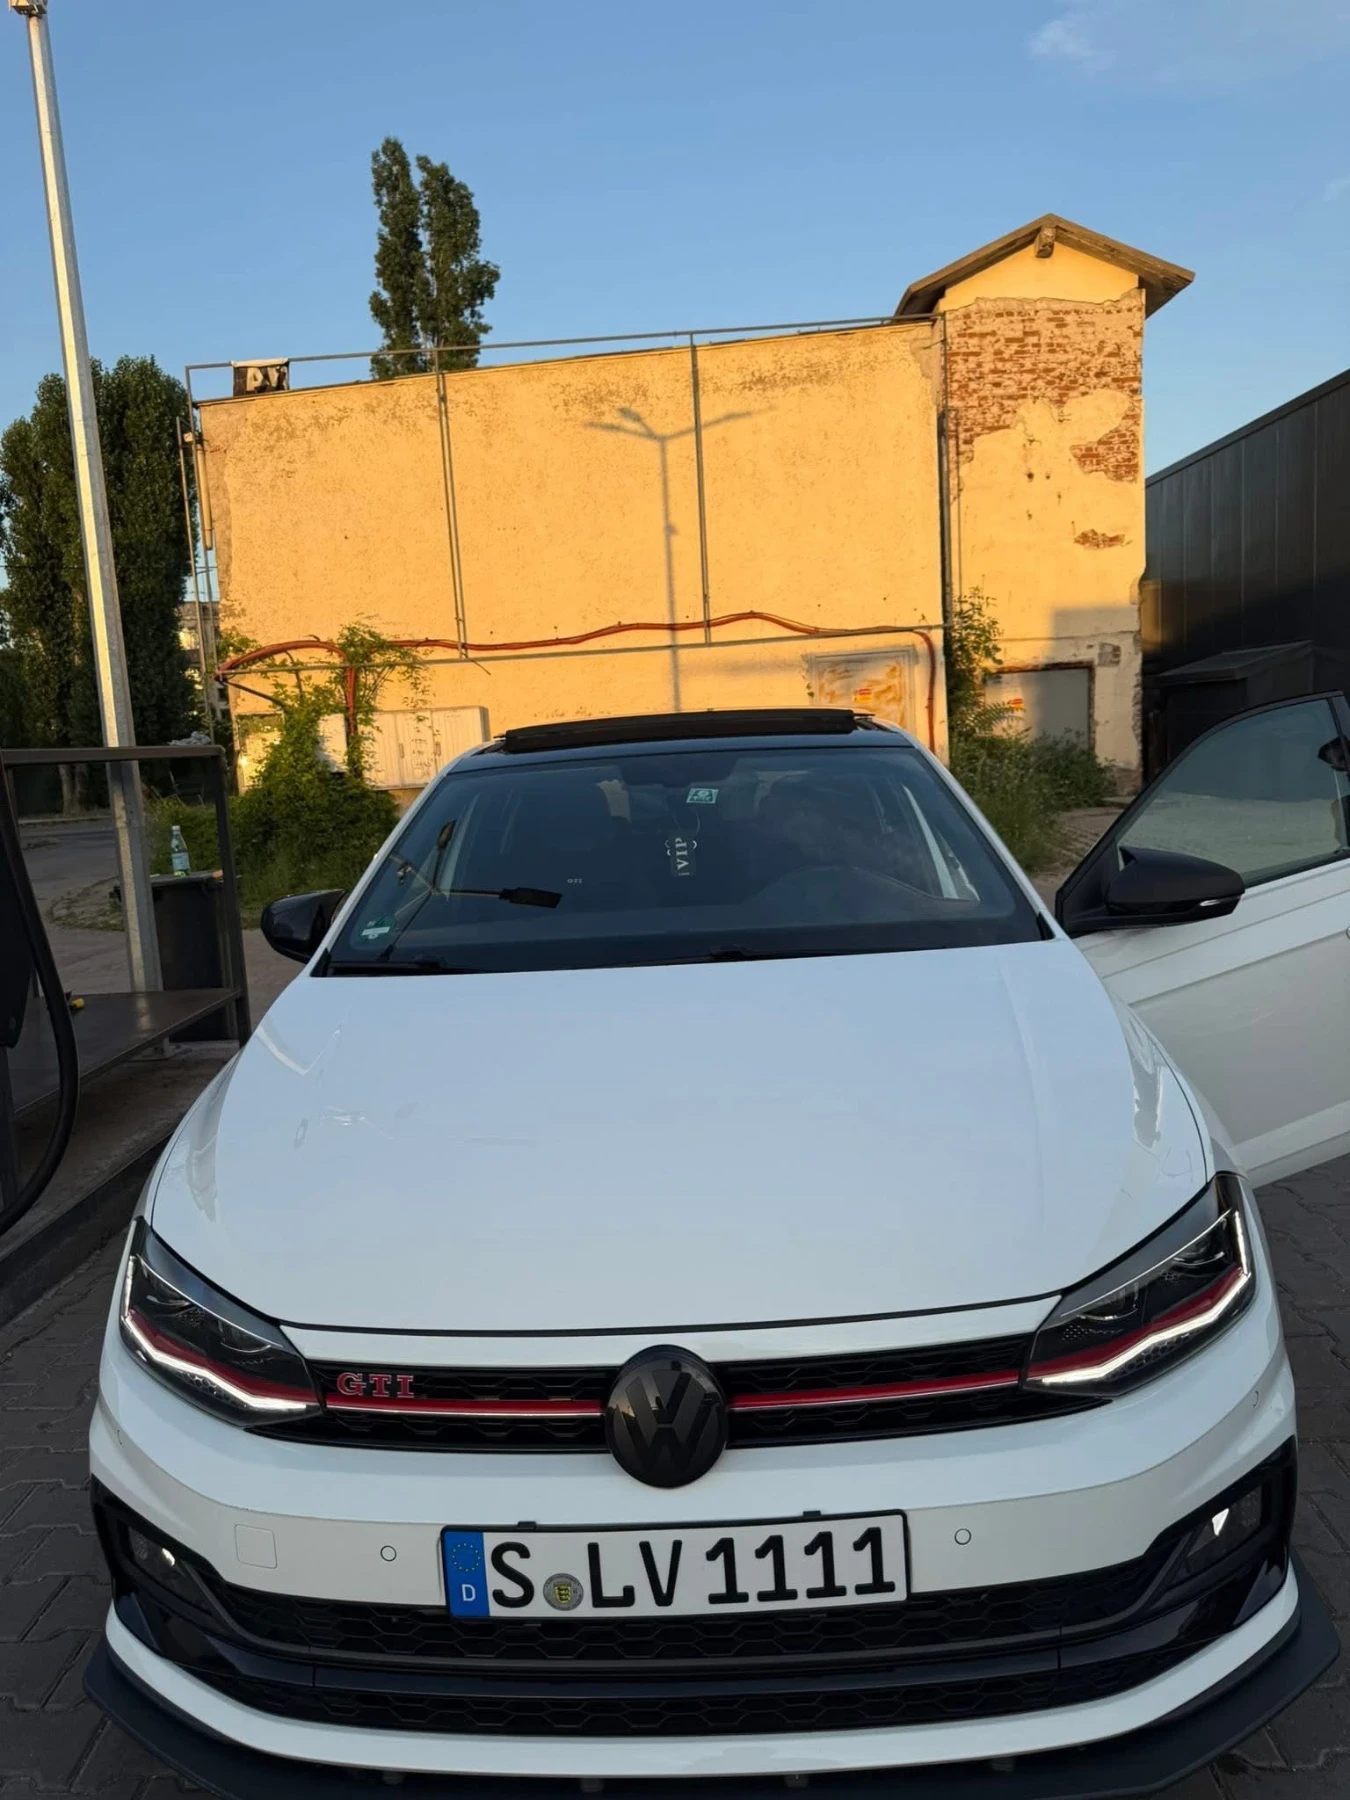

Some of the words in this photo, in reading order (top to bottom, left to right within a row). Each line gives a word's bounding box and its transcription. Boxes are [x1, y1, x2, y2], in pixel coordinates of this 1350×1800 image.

[336, 1372, 415, 1399] GTI
[490, 1541, 535, 1608] S
[587, 1539, 682, 1608] LV
[705, 1526, 896, 1605] 1111
[461, 1583, 476, 1602] D
